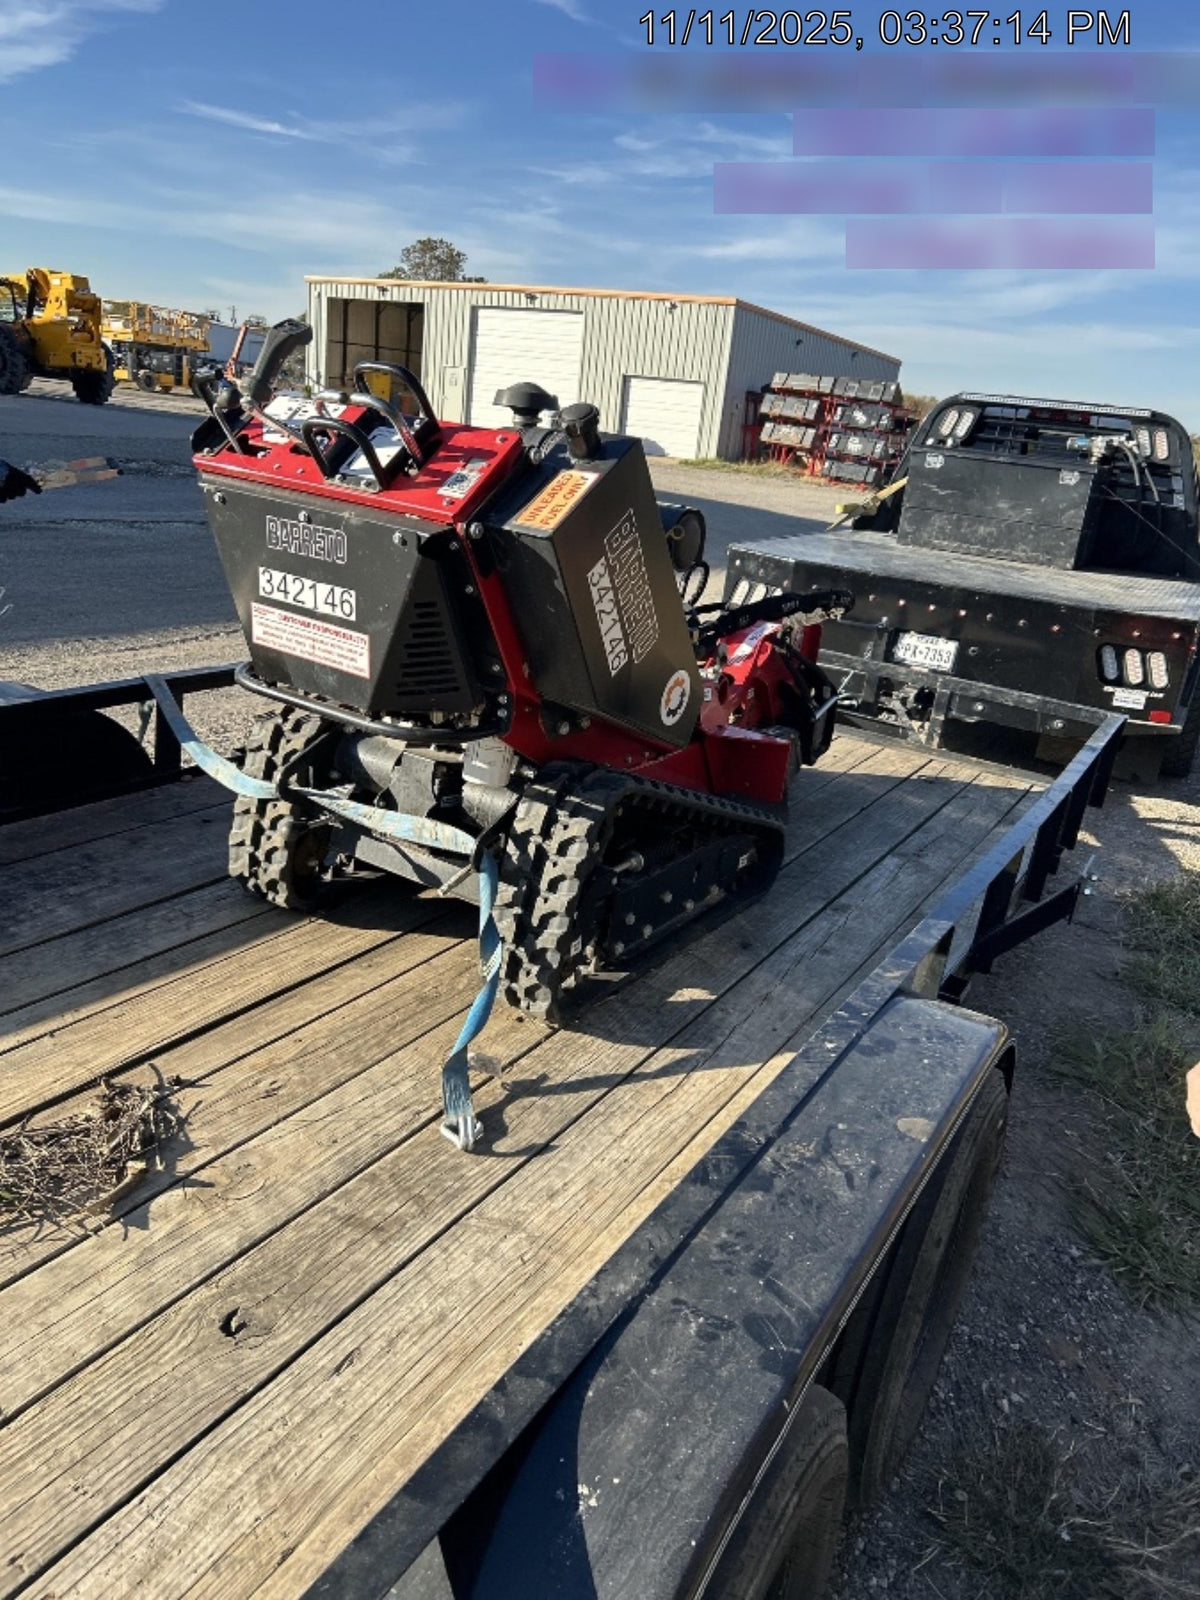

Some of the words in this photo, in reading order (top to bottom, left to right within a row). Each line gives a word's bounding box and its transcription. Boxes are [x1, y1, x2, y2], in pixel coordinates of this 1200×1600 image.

[525, 473, 574, 522] UNLEADED
[540, 501, 568, 526] FUEL
[563, 475, 589, 500] ONLY
[265, 514, 348, 565] BARRETO
[260, 568, 354, 618] 342146
[604, 508, 660, 664] BARRETO
[590, 561, 628, 672] 342146
